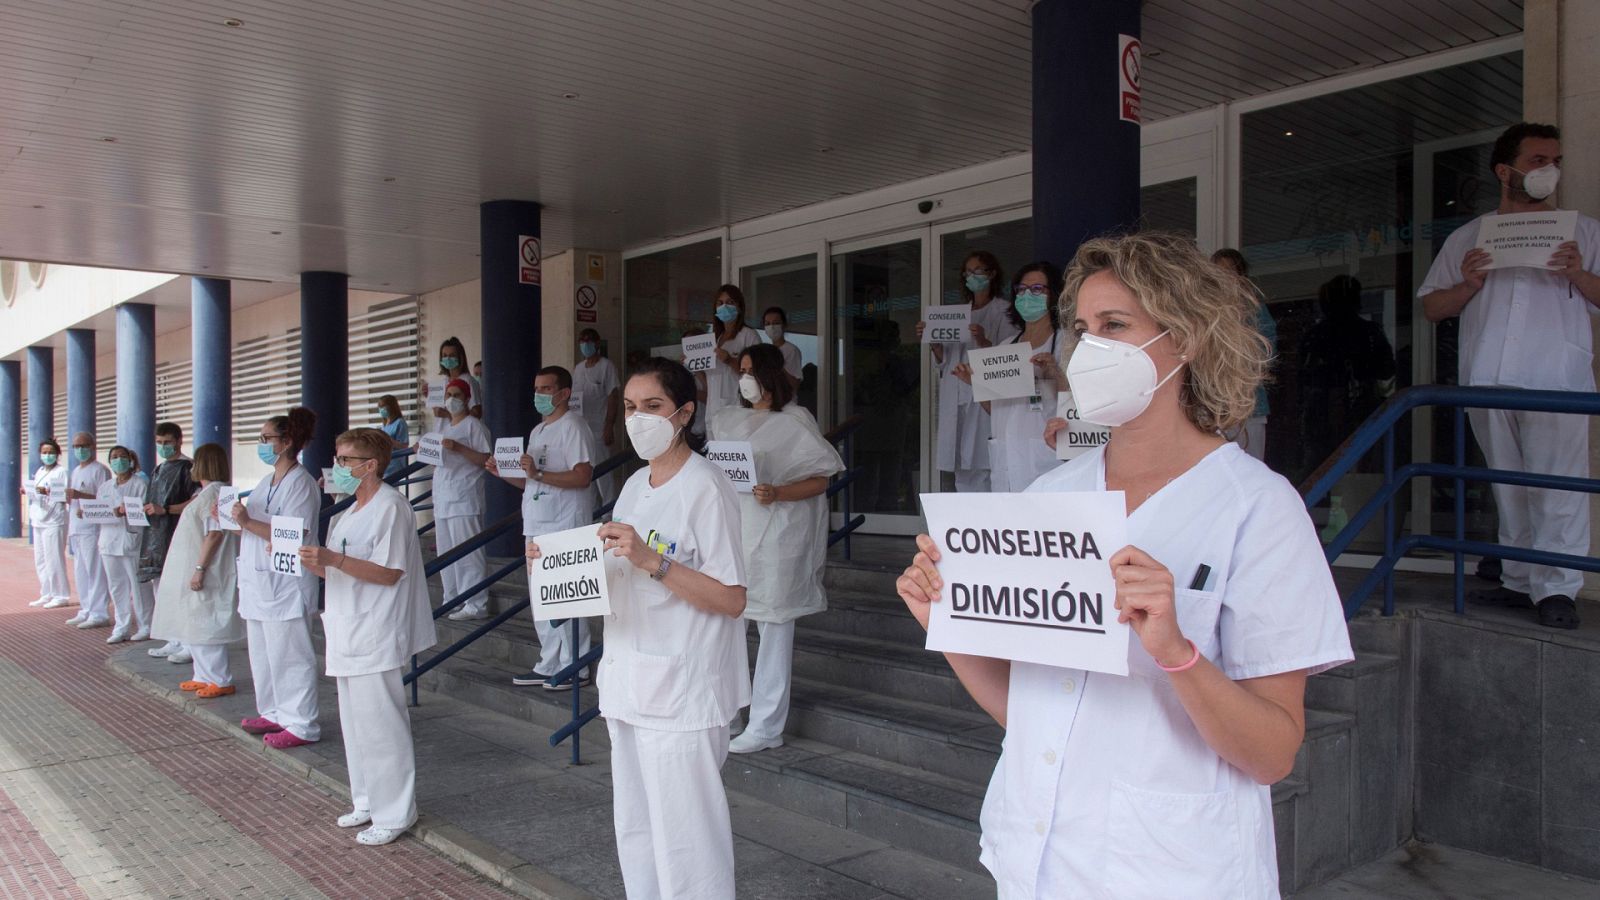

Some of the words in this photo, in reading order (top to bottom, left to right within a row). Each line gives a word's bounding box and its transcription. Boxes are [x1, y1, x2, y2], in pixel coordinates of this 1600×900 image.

[1498, 220, 1525, 228] VENTURA
[928, 312, 966, 321] CONSEJERA
[931, 327, 961, 341] CESE
[685, 340, 713, 351] CONSEJERA
[688, 356, 712, 371] CESE
[982, 353, 1020, 367] VENTURA
[983, 368, 1021, 381] DIMISION
[1068, 431, 1112, 445] DIMISI
[496, 446, 520, 455] CONSEJERA
[708, 452, 748, 462] ONSEJERA
[726, 467, 750, 480] SIÓN
[273, 528, 300, 540] CONSEJERA
[945, 527, 1103, 561] CONSEJERA
[273, 551, 296, 574] CESE
[542, 546, 598, 571] CONSEJERA
[540, 575, 600, 602] DIMISIÓN
[950, 581, 1104, 626] DIMISIÓN
